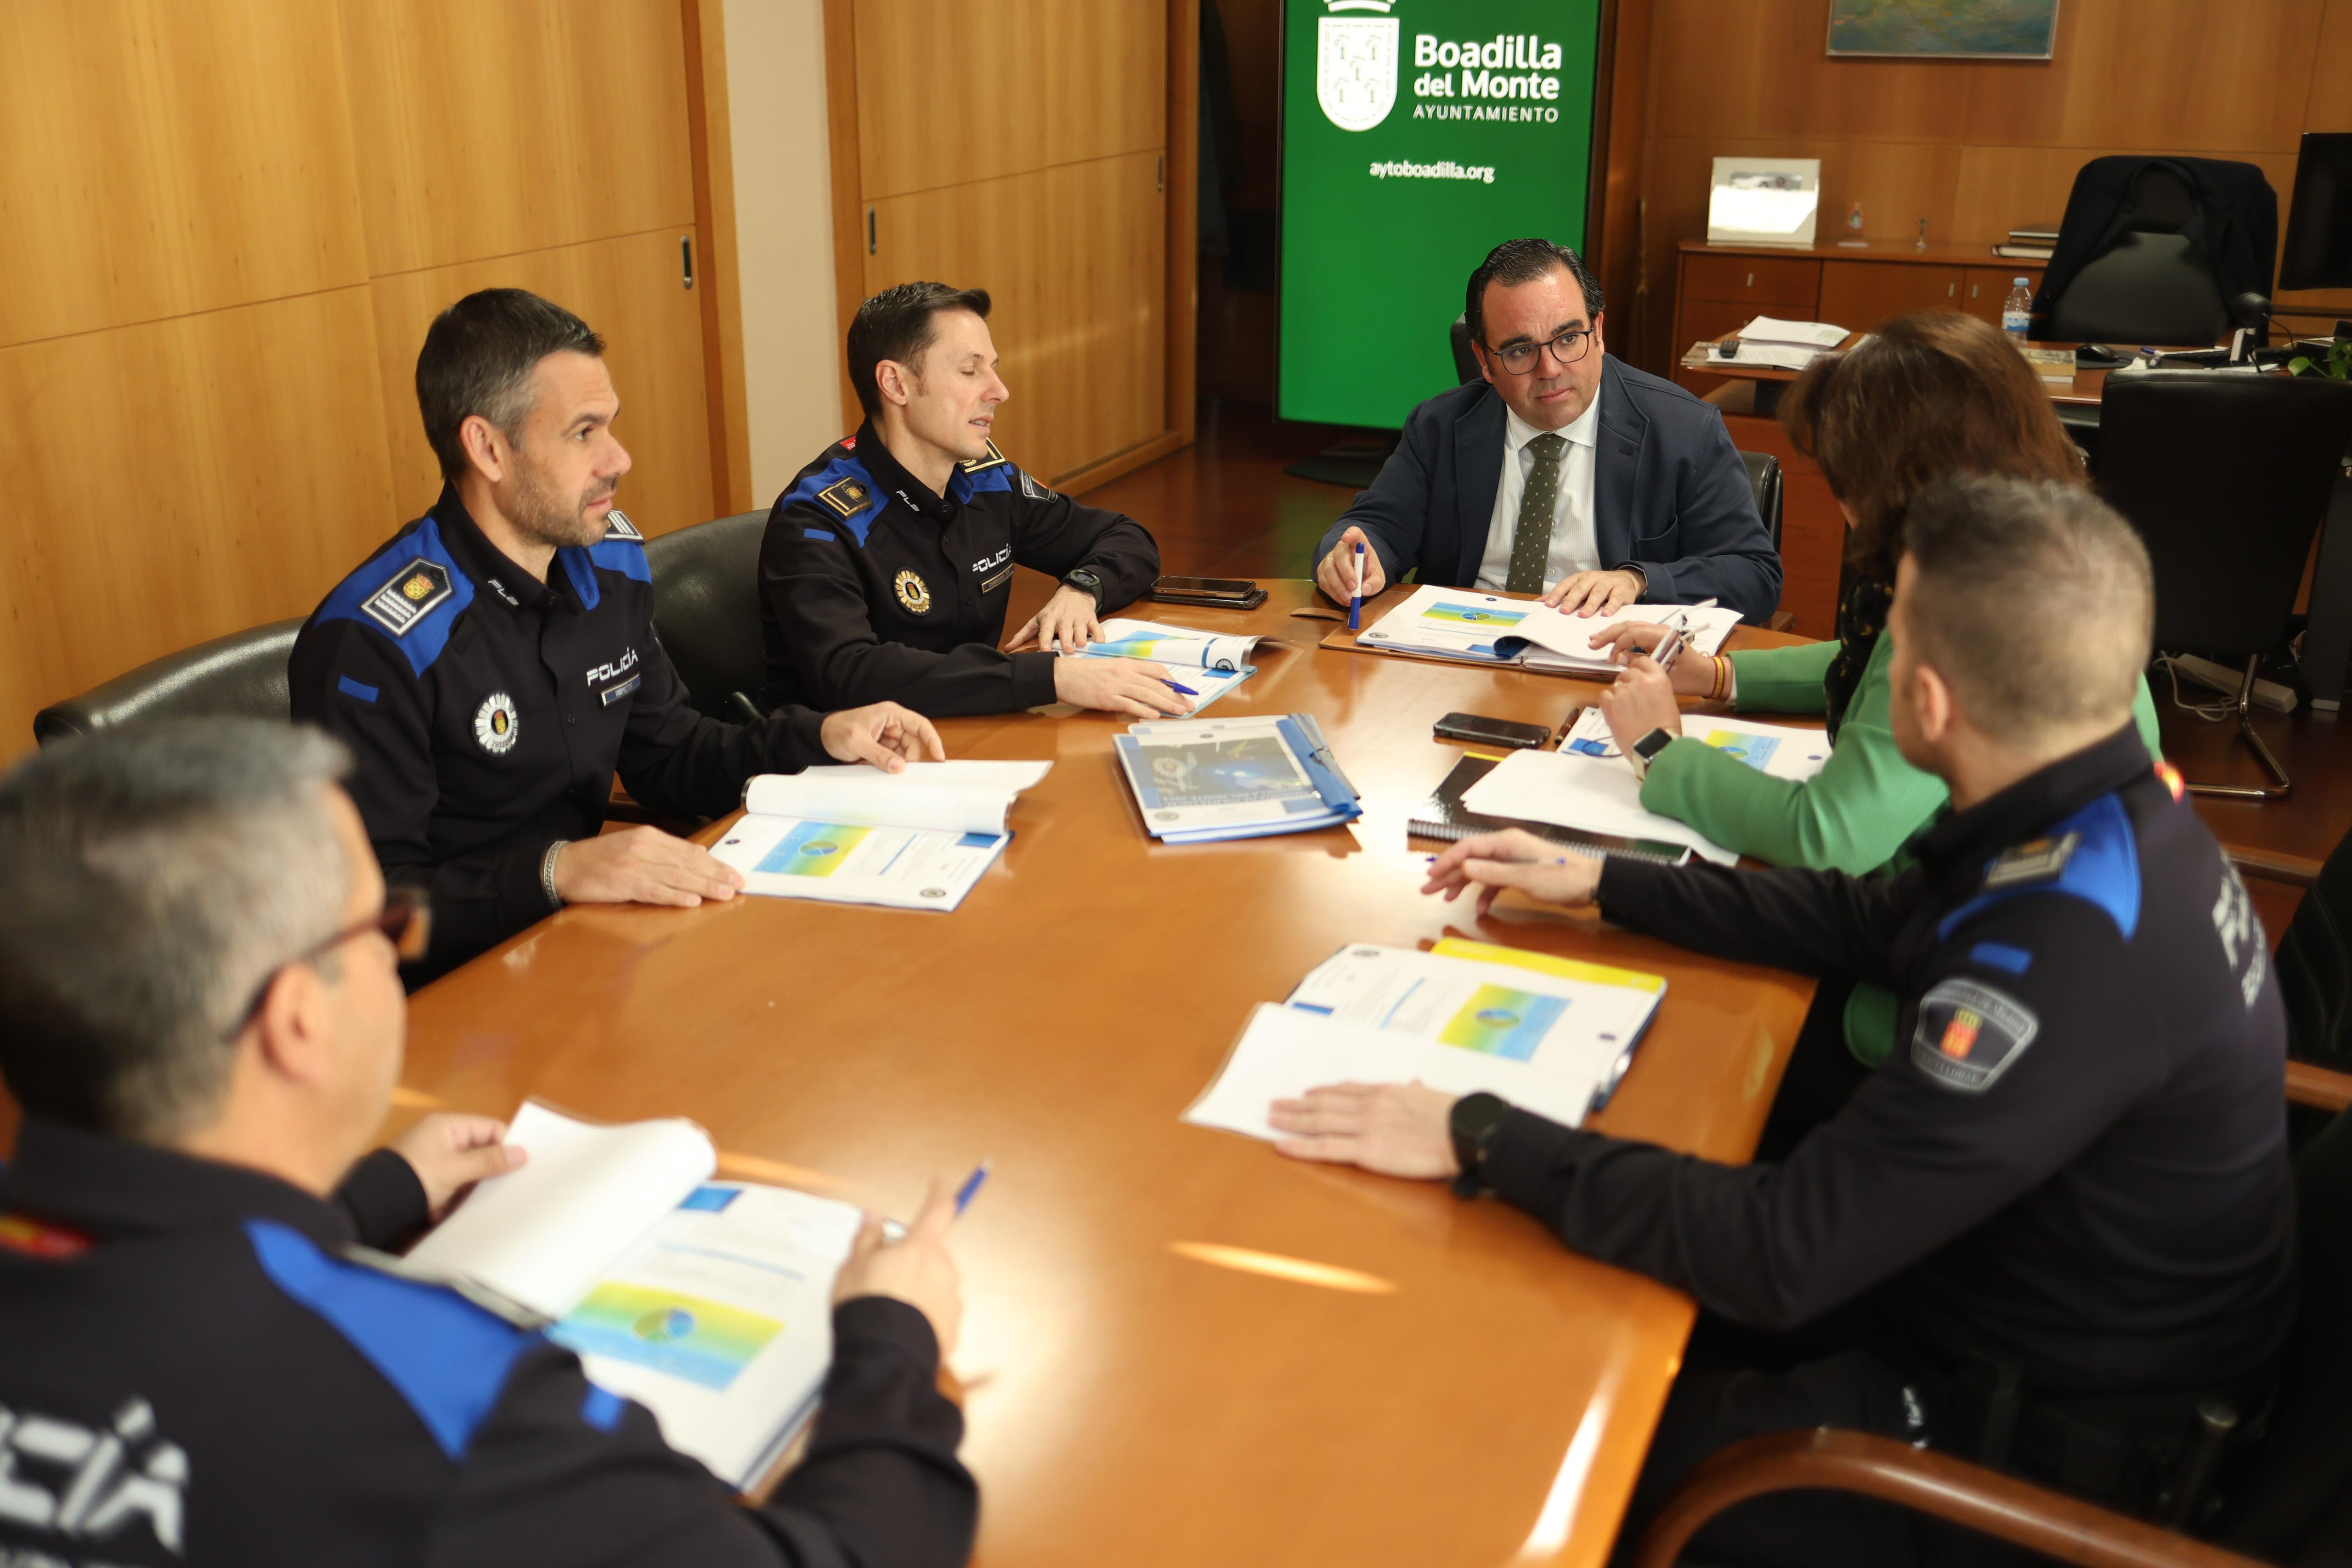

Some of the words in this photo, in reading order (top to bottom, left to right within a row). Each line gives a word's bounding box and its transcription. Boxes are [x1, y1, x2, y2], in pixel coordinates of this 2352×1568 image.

[1414, 34, 1562, 70] Boadilla
[1413, 72, 1455, 97] del
[1461, 70, 1560, 100] Monte
[1413, 103, 1559, 124] AYUNTAMIENTO
[1369, 160, 1496, 184] aytoboadilla.org
[586, 646, 639, 686] POLICÍA
